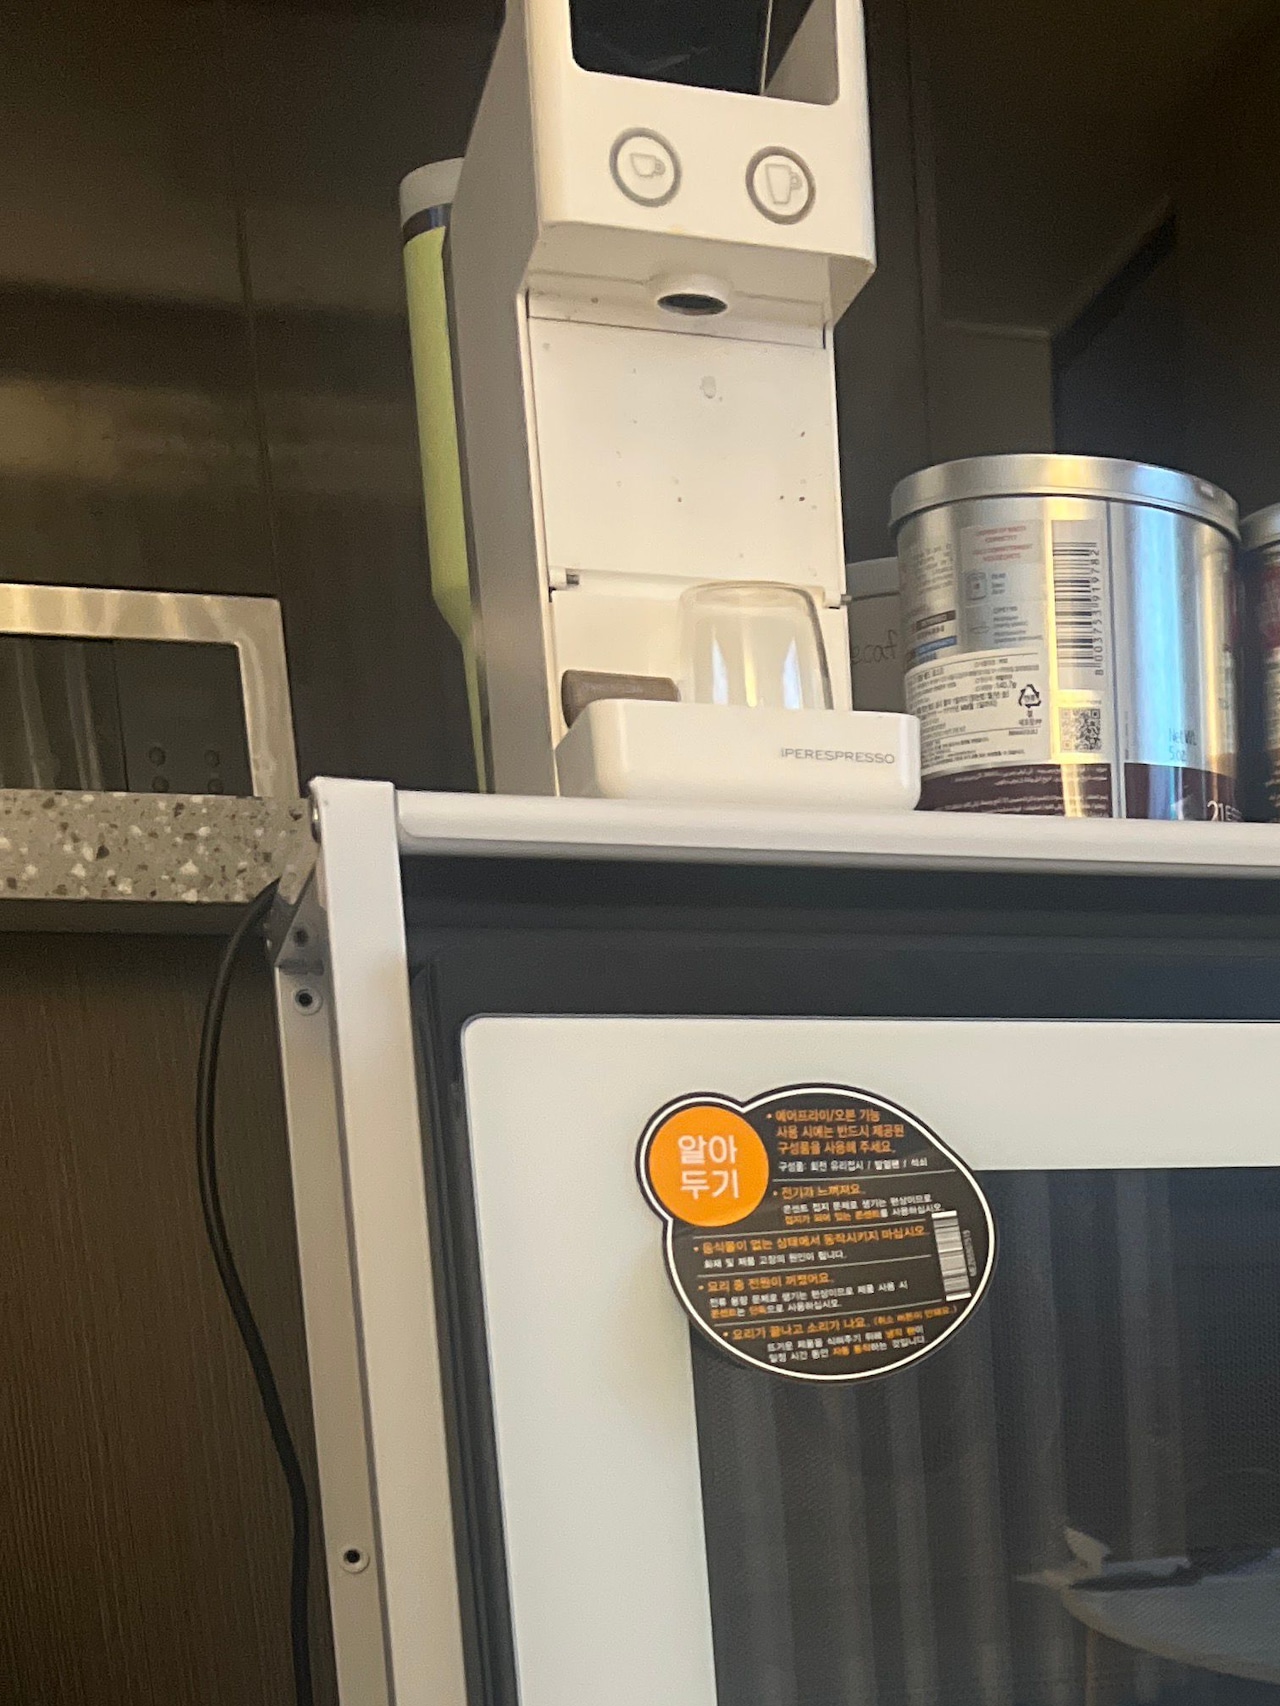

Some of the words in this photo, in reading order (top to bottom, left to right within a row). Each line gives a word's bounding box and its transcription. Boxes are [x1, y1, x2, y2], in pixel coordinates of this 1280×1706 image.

[850, 629, 898, 665] ecaf
[781, 748, 895, 764] IPERESPRESSO
[775, 1109, 856, 1122] 에어프라이/오븐
[859, 1108, 881, 1122] 기능
[776, 1125, 798, 1139] 사용
[802, 1124, 834, 1139] 시에는
[836, 1124, 870, 1138] 반드시
[872, 1123, 905, 1138] 제공된
[677, 1134, 738, 1165] 알아
[778, 1141, 821, 1156] 구성품을
[824, 1141, 857, 1155] 사용해
[859, 1140, 896, 1154] 주세요.
[778, 1160, 807, 1173] 구성품:
[830, 1159, 864, 1171] 유리접시
[681, 1169, 740, 1200] 두기
[781, 1185, 815, 1200] 전기가
[817, 1183, 866, 1197] 느껴져요.
[832, 1200, 859, 1211] 문제로
[861, 1198, 888, 1210] 생기는
[890, 1194, 933, 1207] 현상이므로
[892, 1203, 945, 1217] 사용하십시오.
[702, 1239, 748, 1255] 음식물이
[750, 1238, 773, 1251] 없는
[777, 1235, 821, 1250] 상태에서
[824, 1230, 879, 1246] 동작시키지
[881, 1225, 931, 1240] 마십시오.
[725, 1257, 735, 1268] 및
[738, 1256, 755, 1267] 제품
[758, 1253, 786, 1265] 고장의
[789, 1252, 815, 1263] 원인이
[818, 1250, 847, 1262] 됩니다.
[707, 1279, 730, 1293] 요리
[733, 1278, 745, 1291] 중
[748, 1276, 782, 1291] 전원이
[785, 1271, 834, 1286] 꺼졌어요.
[751, 1293, 778, 1305] 문제로
[781, 1291, 808, 1302] 생기는
[811, 1286, 854, 1300] 현상이므로
[857, 1284, 875, 1296] 제품
[878, 1281, 896, 1292] 사용
[898, 1280, 909, 1290] 시
[788, 1299, 842, 1312] 사용하십시오.
[732, 1327, 766, 1340] 요리가
[769, 1323, 804, 1338] 끝나고
[806, 1319, 840, 1334] 소리가
[843, 1316, 870, 1329] 나요.
[767, 1340, 794, 1353] 뜨거운
[797, 1337, 824, 1350] 제품을
[790, 1349, 809, 1361] 시간
